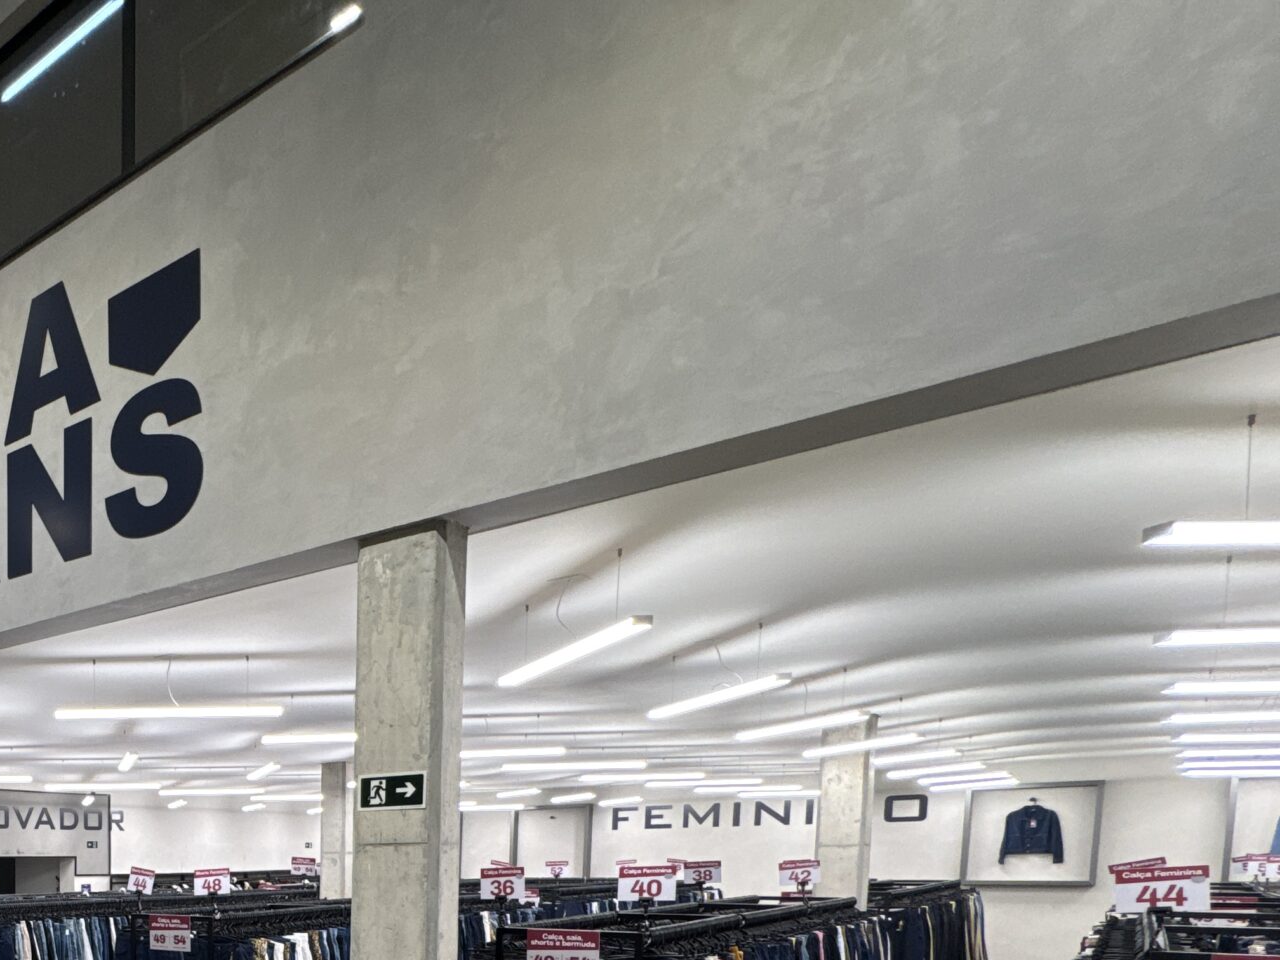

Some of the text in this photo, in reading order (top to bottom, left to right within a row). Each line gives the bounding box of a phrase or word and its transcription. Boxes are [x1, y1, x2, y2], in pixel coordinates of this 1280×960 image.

[611, 794, 928, 831] FEMINIO
[692, 869, 713, 881] 38
[788, 870, 812, 882] 42
[1122, 869, 1203, 879] Calça Feminina
[133, 877, 147, 890] 44
[202, 879, 222, 891] 48
[490, 879, 515, 896] 36
[630, 879, 663, 897] 40
[1136, 884, 1188, 907] 44
[561, 940, 595, 948] bermuda
